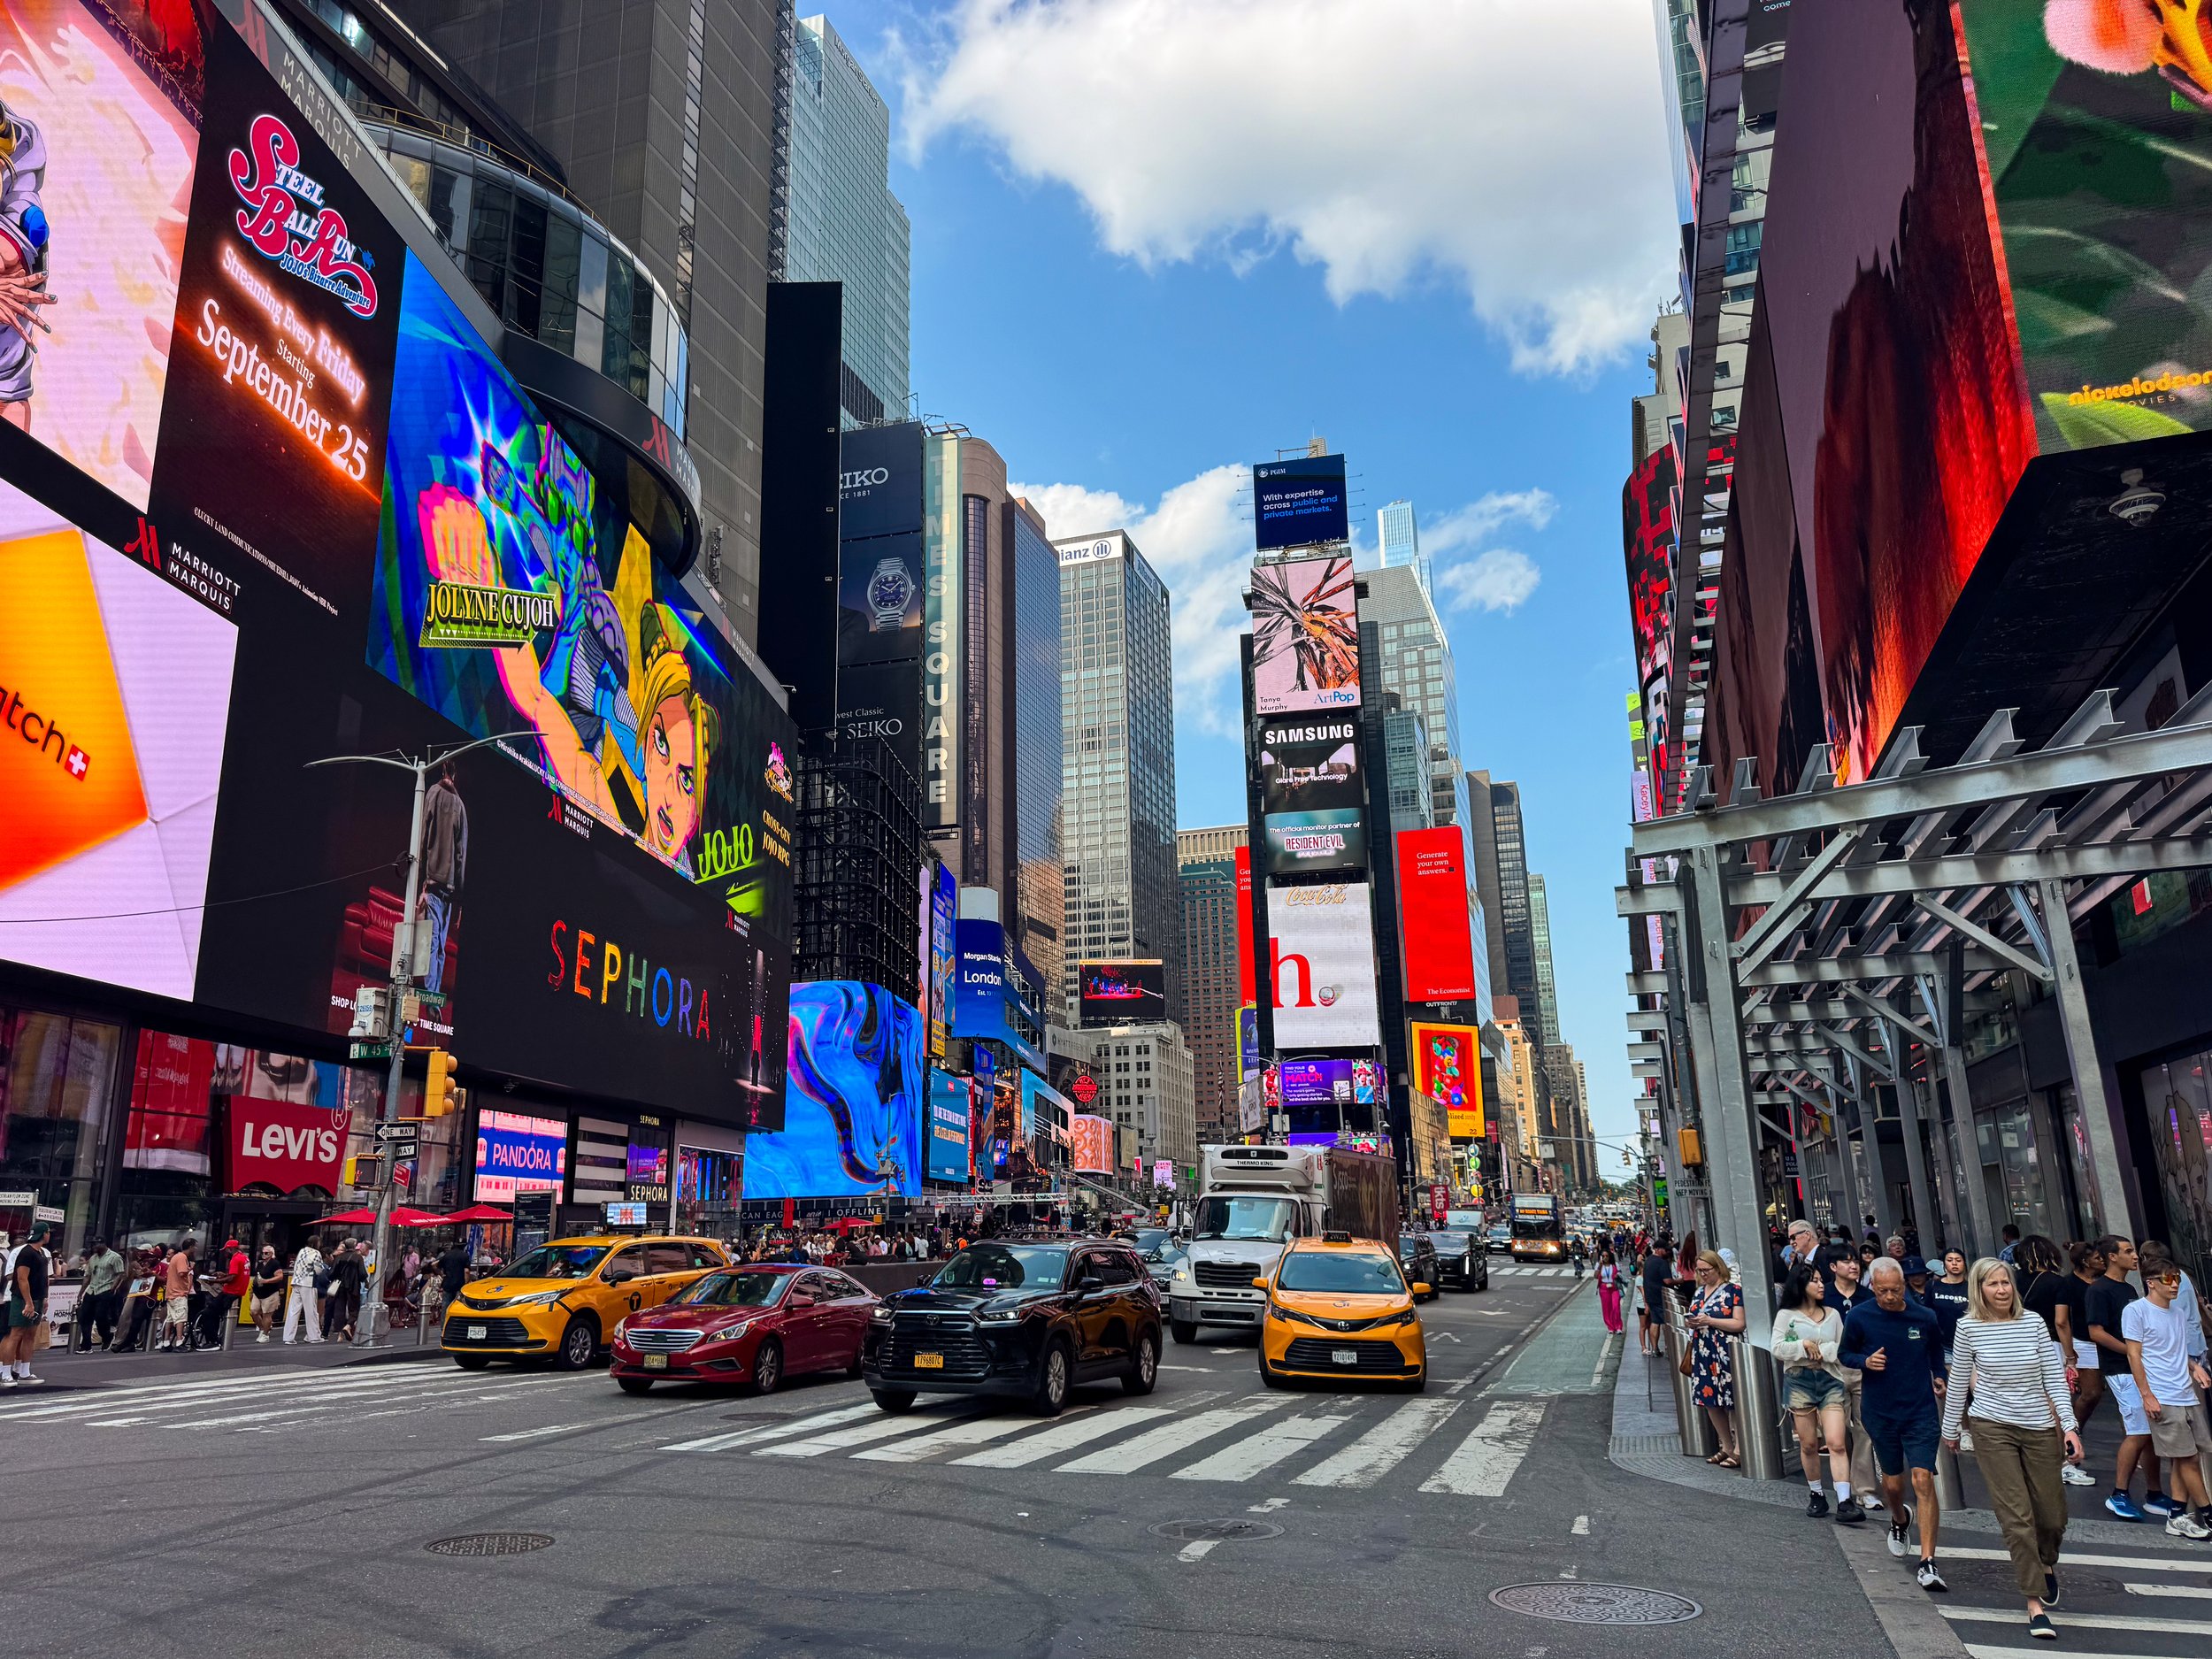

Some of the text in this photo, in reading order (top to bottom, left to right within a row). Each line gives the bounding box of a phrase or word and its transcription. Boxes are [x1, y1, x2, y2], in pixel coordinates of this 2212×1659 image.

[1763, 0, 1791, 12] come
[283, 51, 361, 159] MARRIOTT
[280, 74, 351, 171] MARQUIS
[229, 114, 326, 210] STEEL
[236, 184, 319, 259] BALL
[308, 266, 336, 292] Bizarre
[335, 280, 371, 310] Adventure
[223, 246, 366, 405] Streaming Every Friday
[276, 338, 315, 389] Starting
[196, 297, 370, 481] September 25
[840, 466, 888, 489] IKO
[853, 489, 871, 498] 1881
[1263, 488, 1325, 502] With expertise
[1263, 495, 1338, 511] across public and
[1263, 505, 1332, 520] private markets.
[172, 541, 242, 596] MARRIOTT
[169, 561, 231, 611] MARQUIS
[427, 584, 555, 629] JOLYNE CUJOH
[926, 454, 950, 803] TIMES SQUARE
[1260, 703, 1288, 712] Murphy
[1314, 691, 1355, 704] ArtPop
[855, 707, 885, 717] Classic
[847, 718, 902, 740] SEIKO
[1265, 724, 1355, 745] SAMSUNG
[1310, 773, 1348, 782] Technology
[565, 803, 594, 829] MARRIOTT
[564, 818, 591, 840] MARQUIS
[763, 810, 791, 846] CROSS-GEN
[697, 823, 754, 879] JOJO
[763, 832, 790, 868] JOJO RPG
[1286, 835, 1343, 850] RESIDENT EVIL
[547, 918, 710, 1042] SEPHORA
[964, 971, 1002, 986] London
[331, 995, 349, 1008] SHOP
[416, 990, 445, 1007] Broadway
[420, 1018, 454, 1036] TIME SQUARE
[360, 1046, 368, 1056] W
[372, 1045, 381, 1056] 45
[1285, 1073, 1323, 1083] MATCH
[640, 1115, 660, 1126] SEPHORA
[396, 1147, 411, 1156] WAY
[493, 1142, 551, 1171] PANDORA
[630, 1183, 668, 1202] SEPHORA
[836, 1207, 882, 1217] OFFLINE
